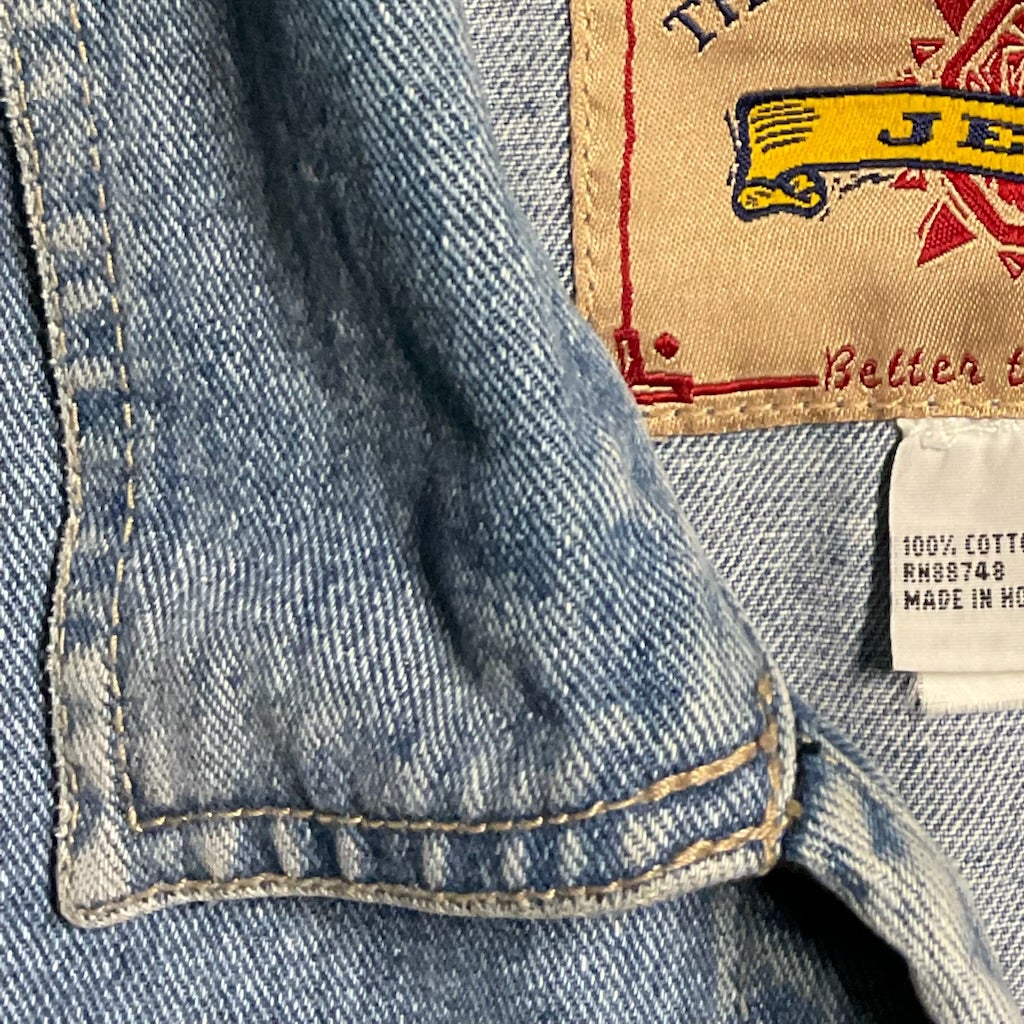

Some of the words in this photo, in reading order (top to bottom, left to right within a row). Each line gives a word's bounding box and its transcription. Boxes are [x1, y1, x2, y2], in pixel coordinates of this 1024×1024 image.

[824, 343, 986, 392] Better
[903, 535, 957, 556] 100%
[903, 588, 964, 611] MADE
[971, 588, 993, 609] IN
